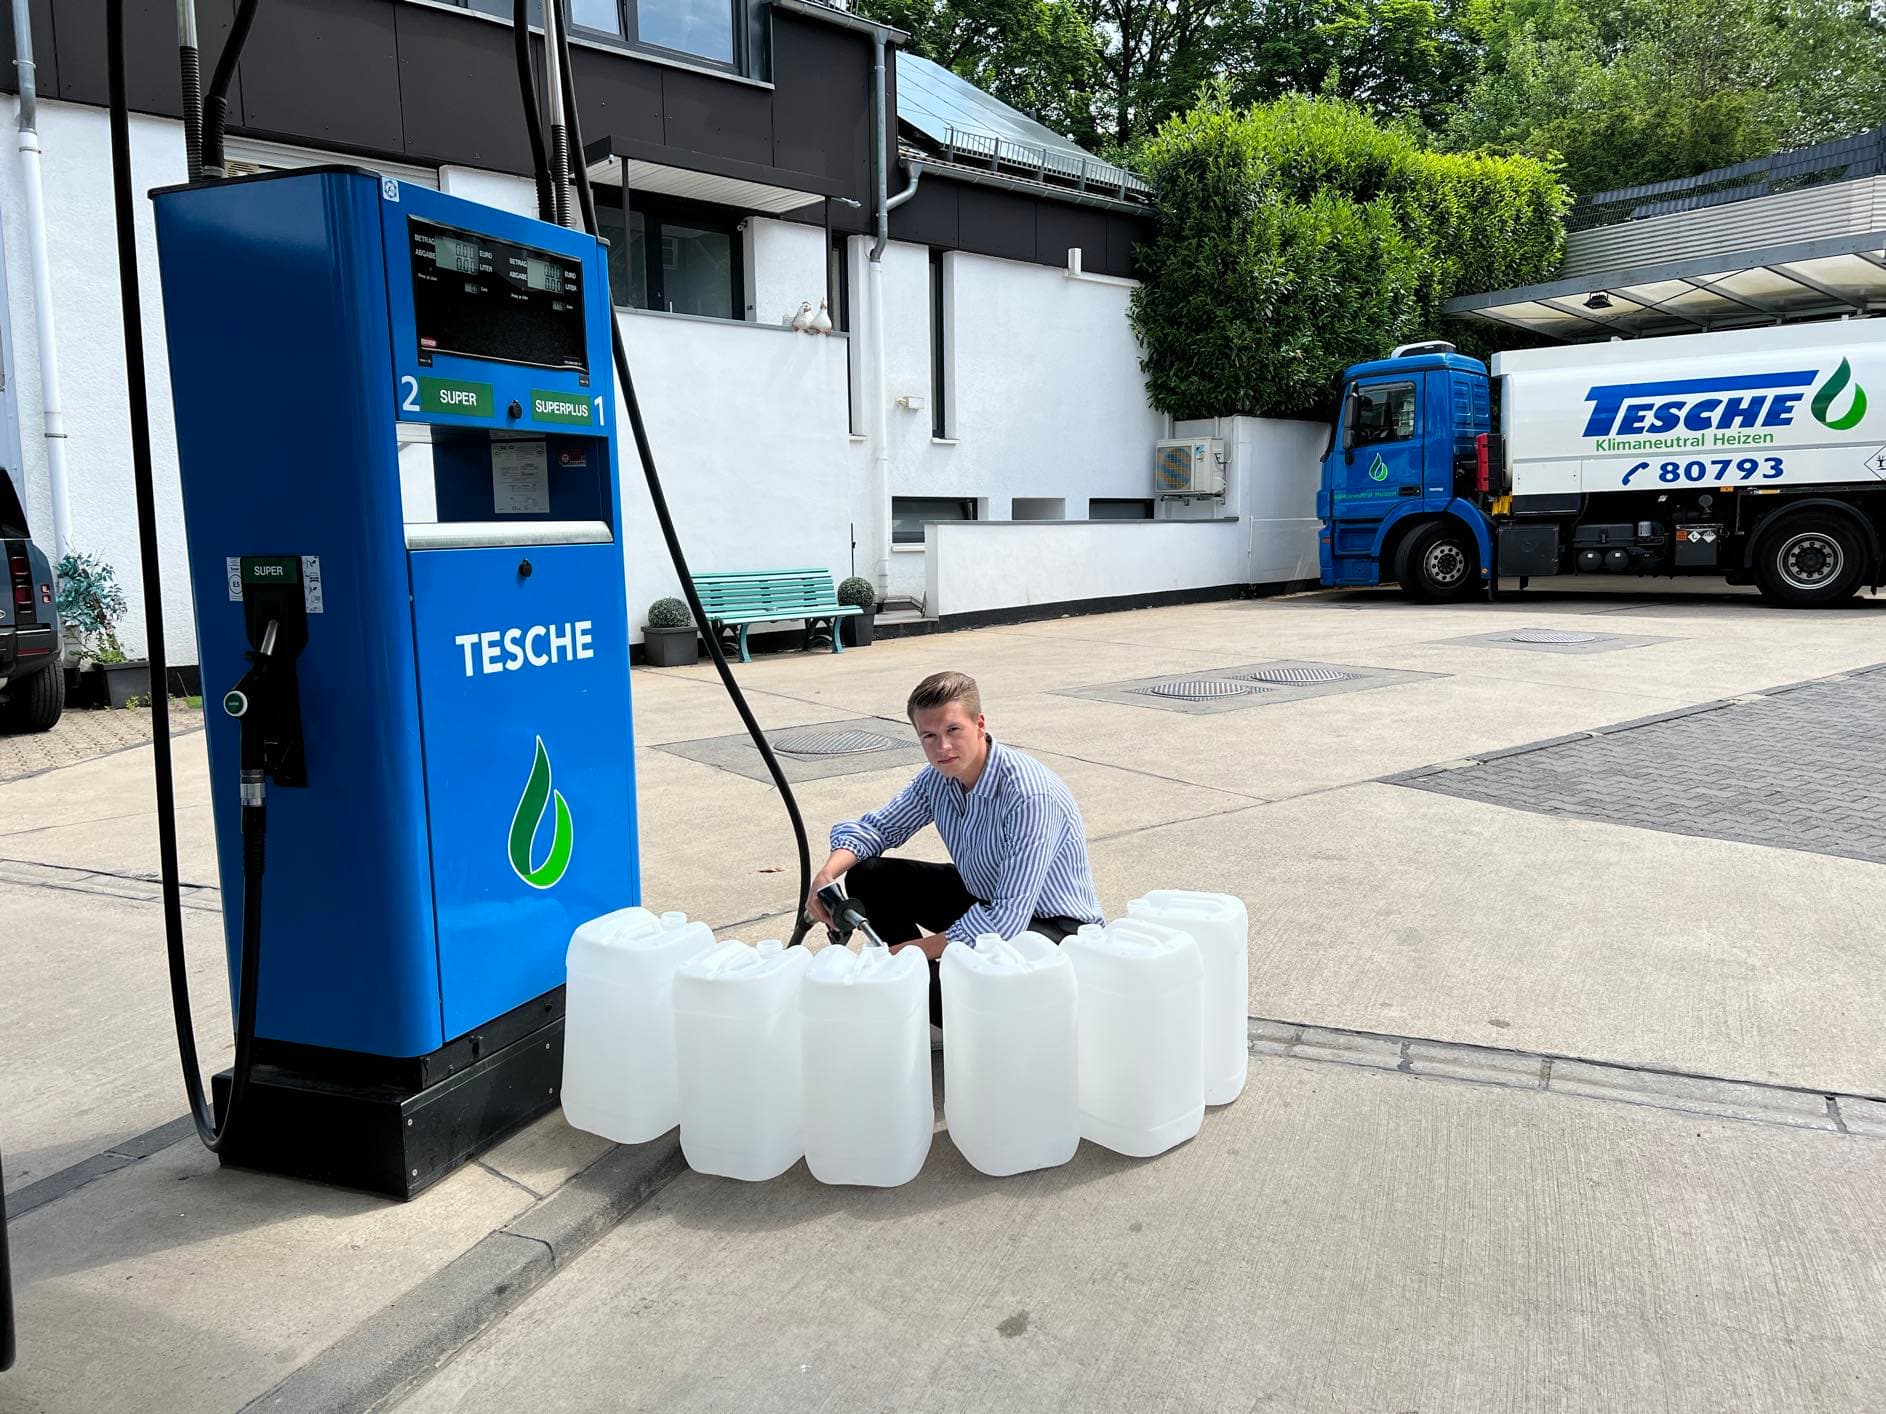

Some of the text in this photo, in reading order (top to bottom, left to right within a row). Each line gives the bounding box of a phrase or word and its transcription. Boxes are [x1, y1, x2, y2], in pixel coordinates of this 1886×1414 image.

[414, 234, 436, 246] BETRAG
[415, 248, 437, 260] ABGABE
[479, 250, 493, 260] EURO
[479, 263, 493, 273] LITER
[509, 257, 528, 268] BETRAG
[509, 271, 528, 281] ABGABE
[564, 270, 577, 280] EURO
[565, 283, 578, 292] LITER
[401, 375, 420, 412] 2
[439, 389, 477, 406] SUPER
[535, 399, 589, 417] SUPERPLUS
[1582, 369, 1820, 438] TESCHE
[594, 395, 605, 426] 1
[1595, 431, 1774, 452] Klimaneutral Heizen
[1658, 456, 1785, 483] 80793
[254, 566, 284, 576] SUPER
[455, 620, 594, 677] TESCHE
